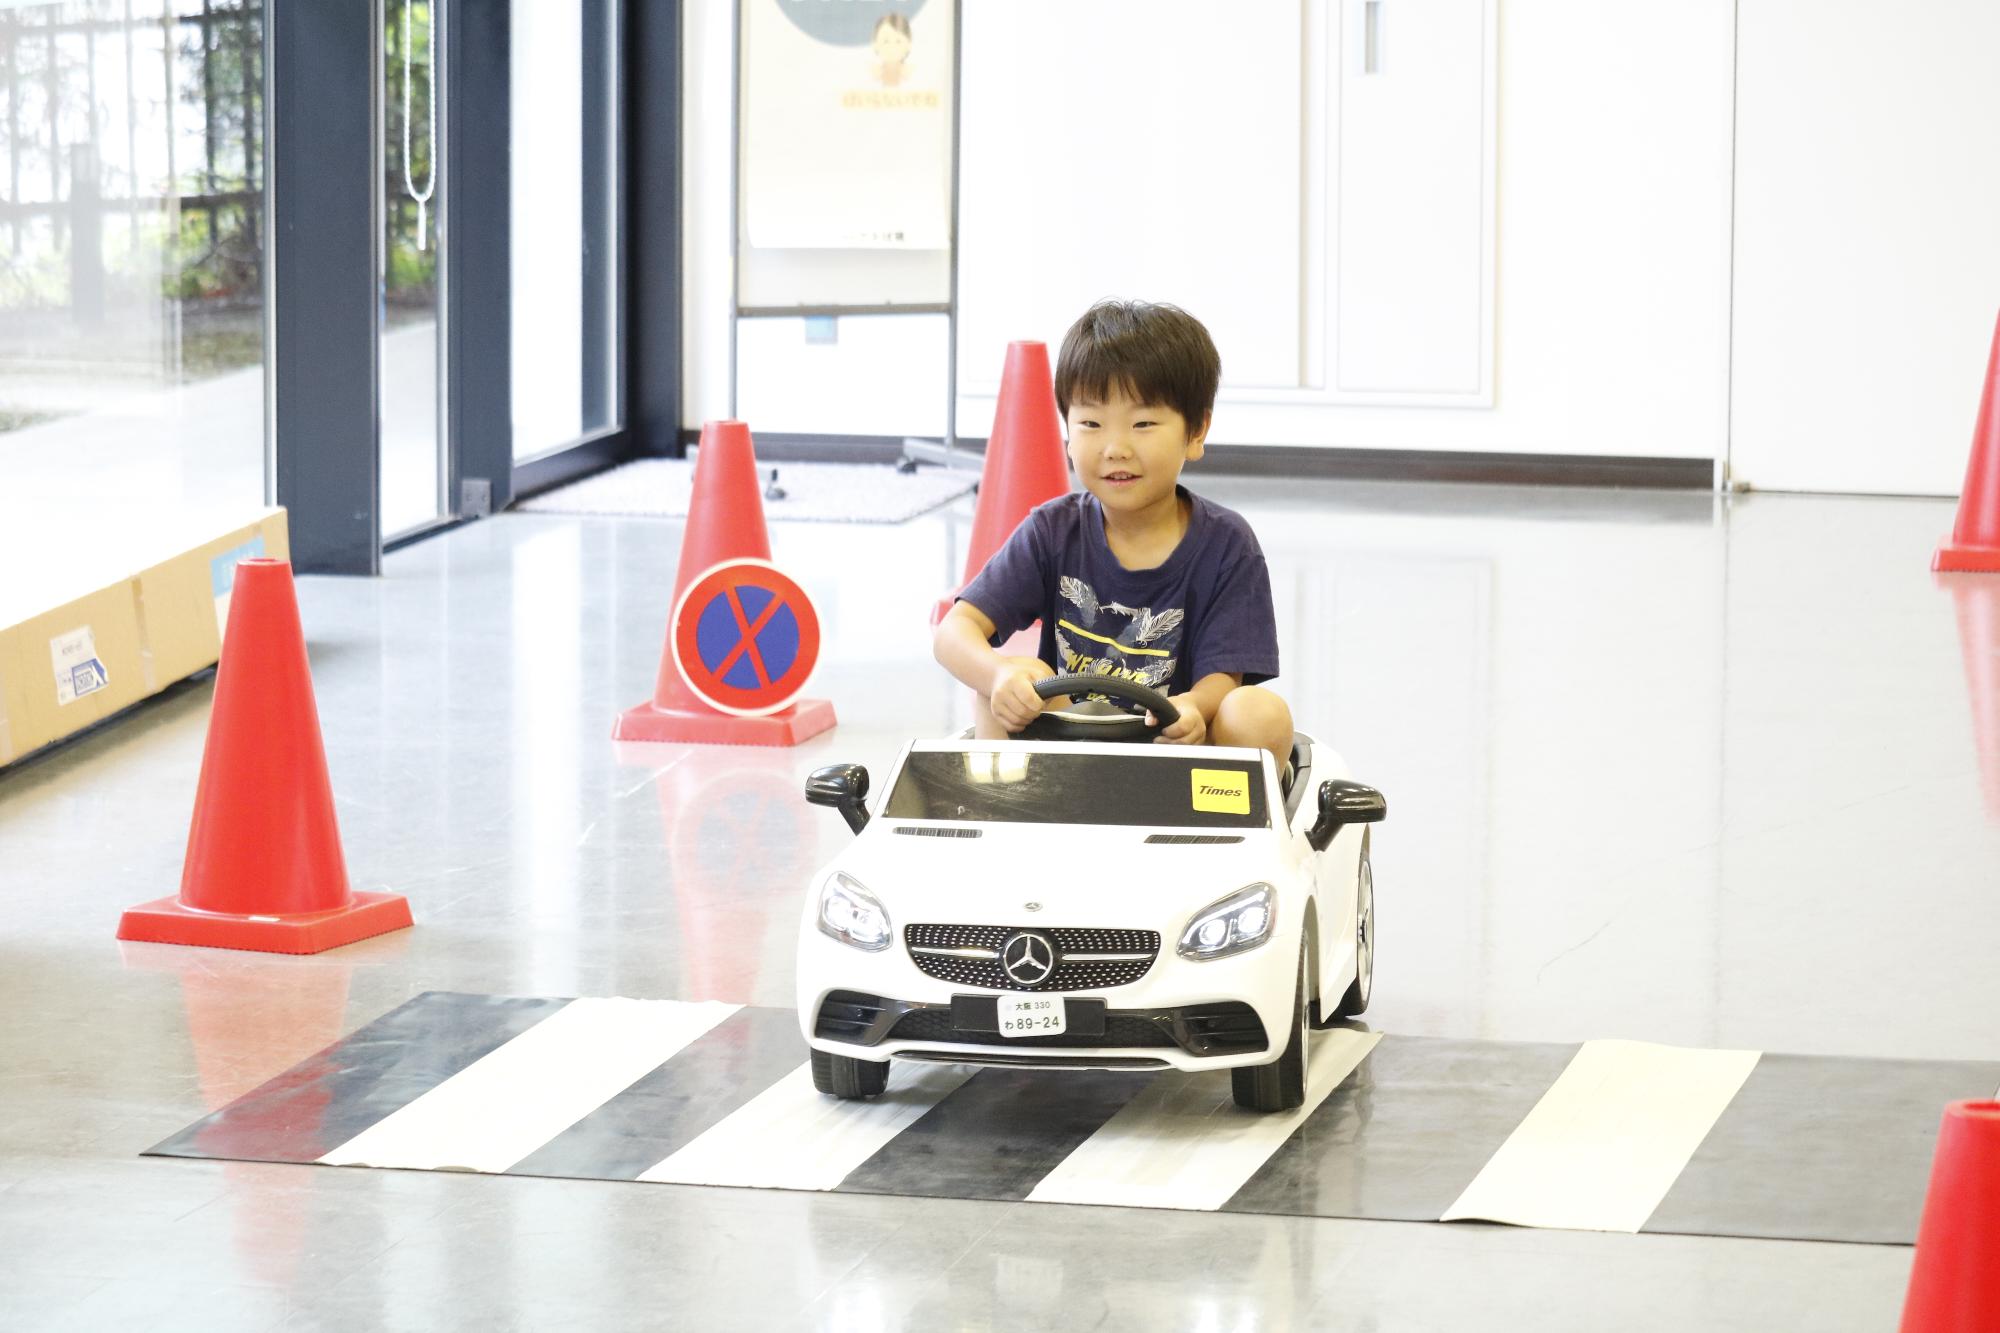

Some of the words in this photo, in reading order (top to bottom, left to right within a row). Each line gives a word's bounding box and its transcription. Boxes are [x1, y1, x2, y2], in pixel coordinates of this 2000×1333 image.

[1199, 785, 1243, 797] Times
[1034, 1001, 1050, 1009] 330
[1016, 1016, 1060, 1030] 89-24
